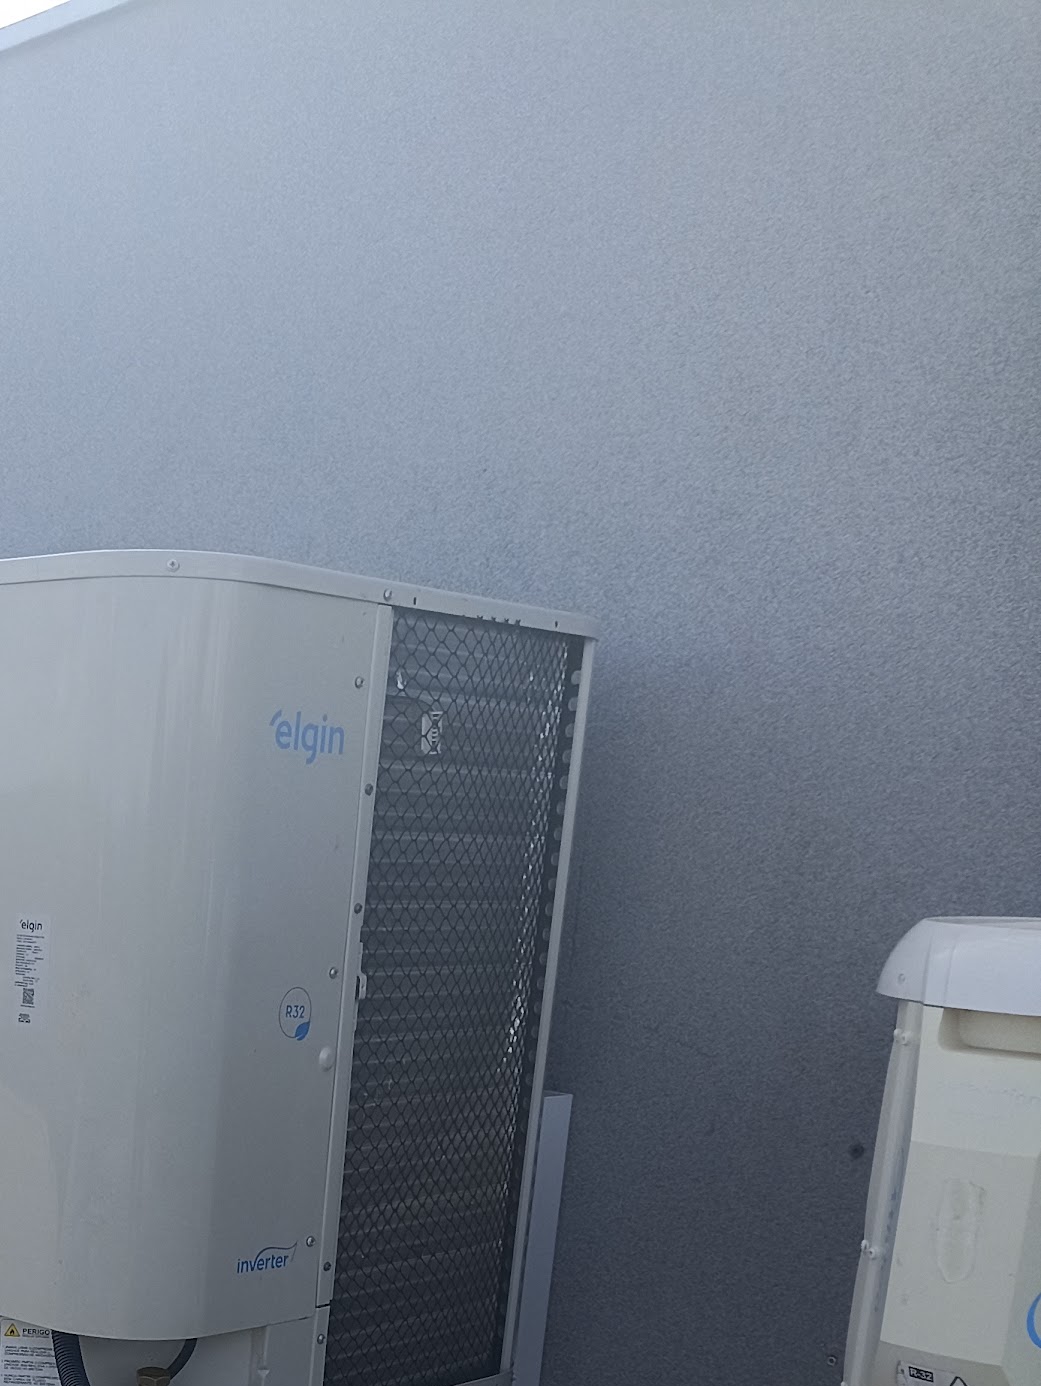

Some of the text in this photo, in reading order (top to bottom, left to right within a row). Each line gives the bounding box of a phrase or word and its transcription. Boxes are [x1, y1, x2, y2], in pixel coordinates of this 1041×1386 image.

[285, 1004, 306, 1019] R32
[237, 1254, 289, 1274] inverter
[22, 1327, 50, 1337] PERIGO
[909, 1367, 933, 1382] R-32
